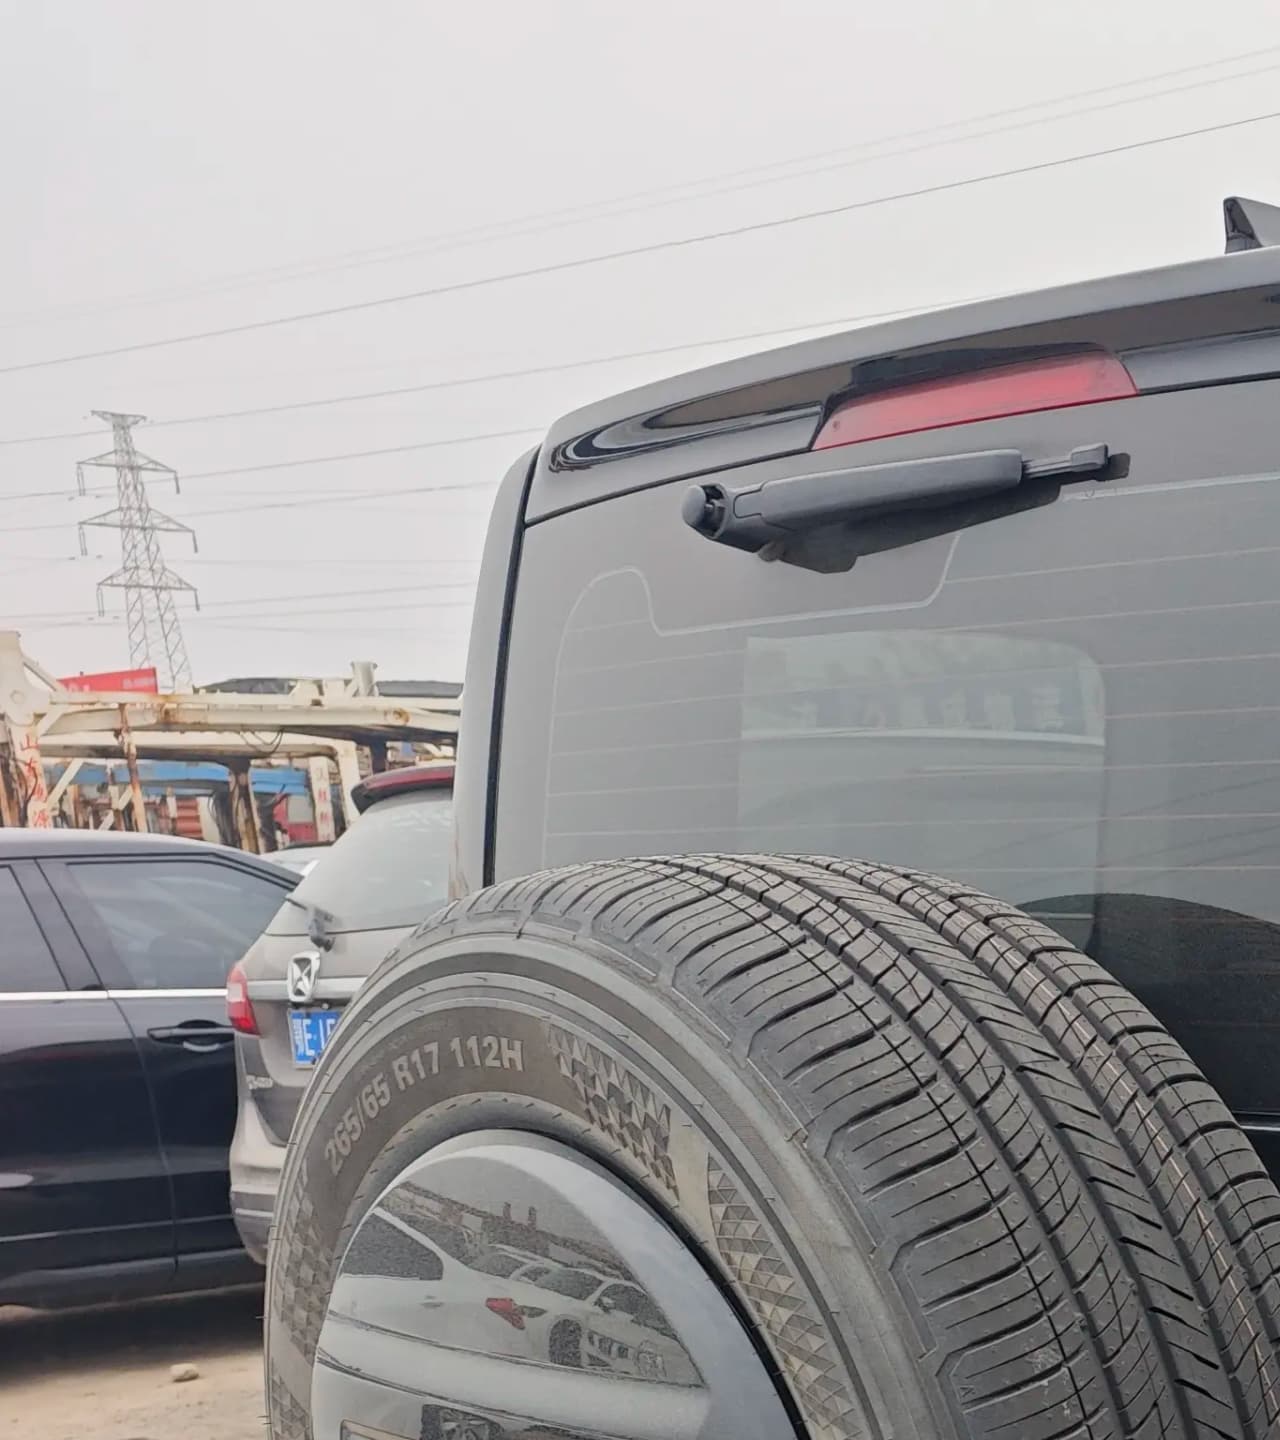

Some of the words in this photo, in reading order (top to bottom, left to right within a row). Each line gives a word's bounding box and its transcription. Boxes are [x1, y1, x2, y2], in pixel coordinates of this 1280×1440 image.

[323, 1071, 392, 1177] 265/65
[392, 1041, 440, 1092] R17
[450, 1035, 525, 1073] 112H
